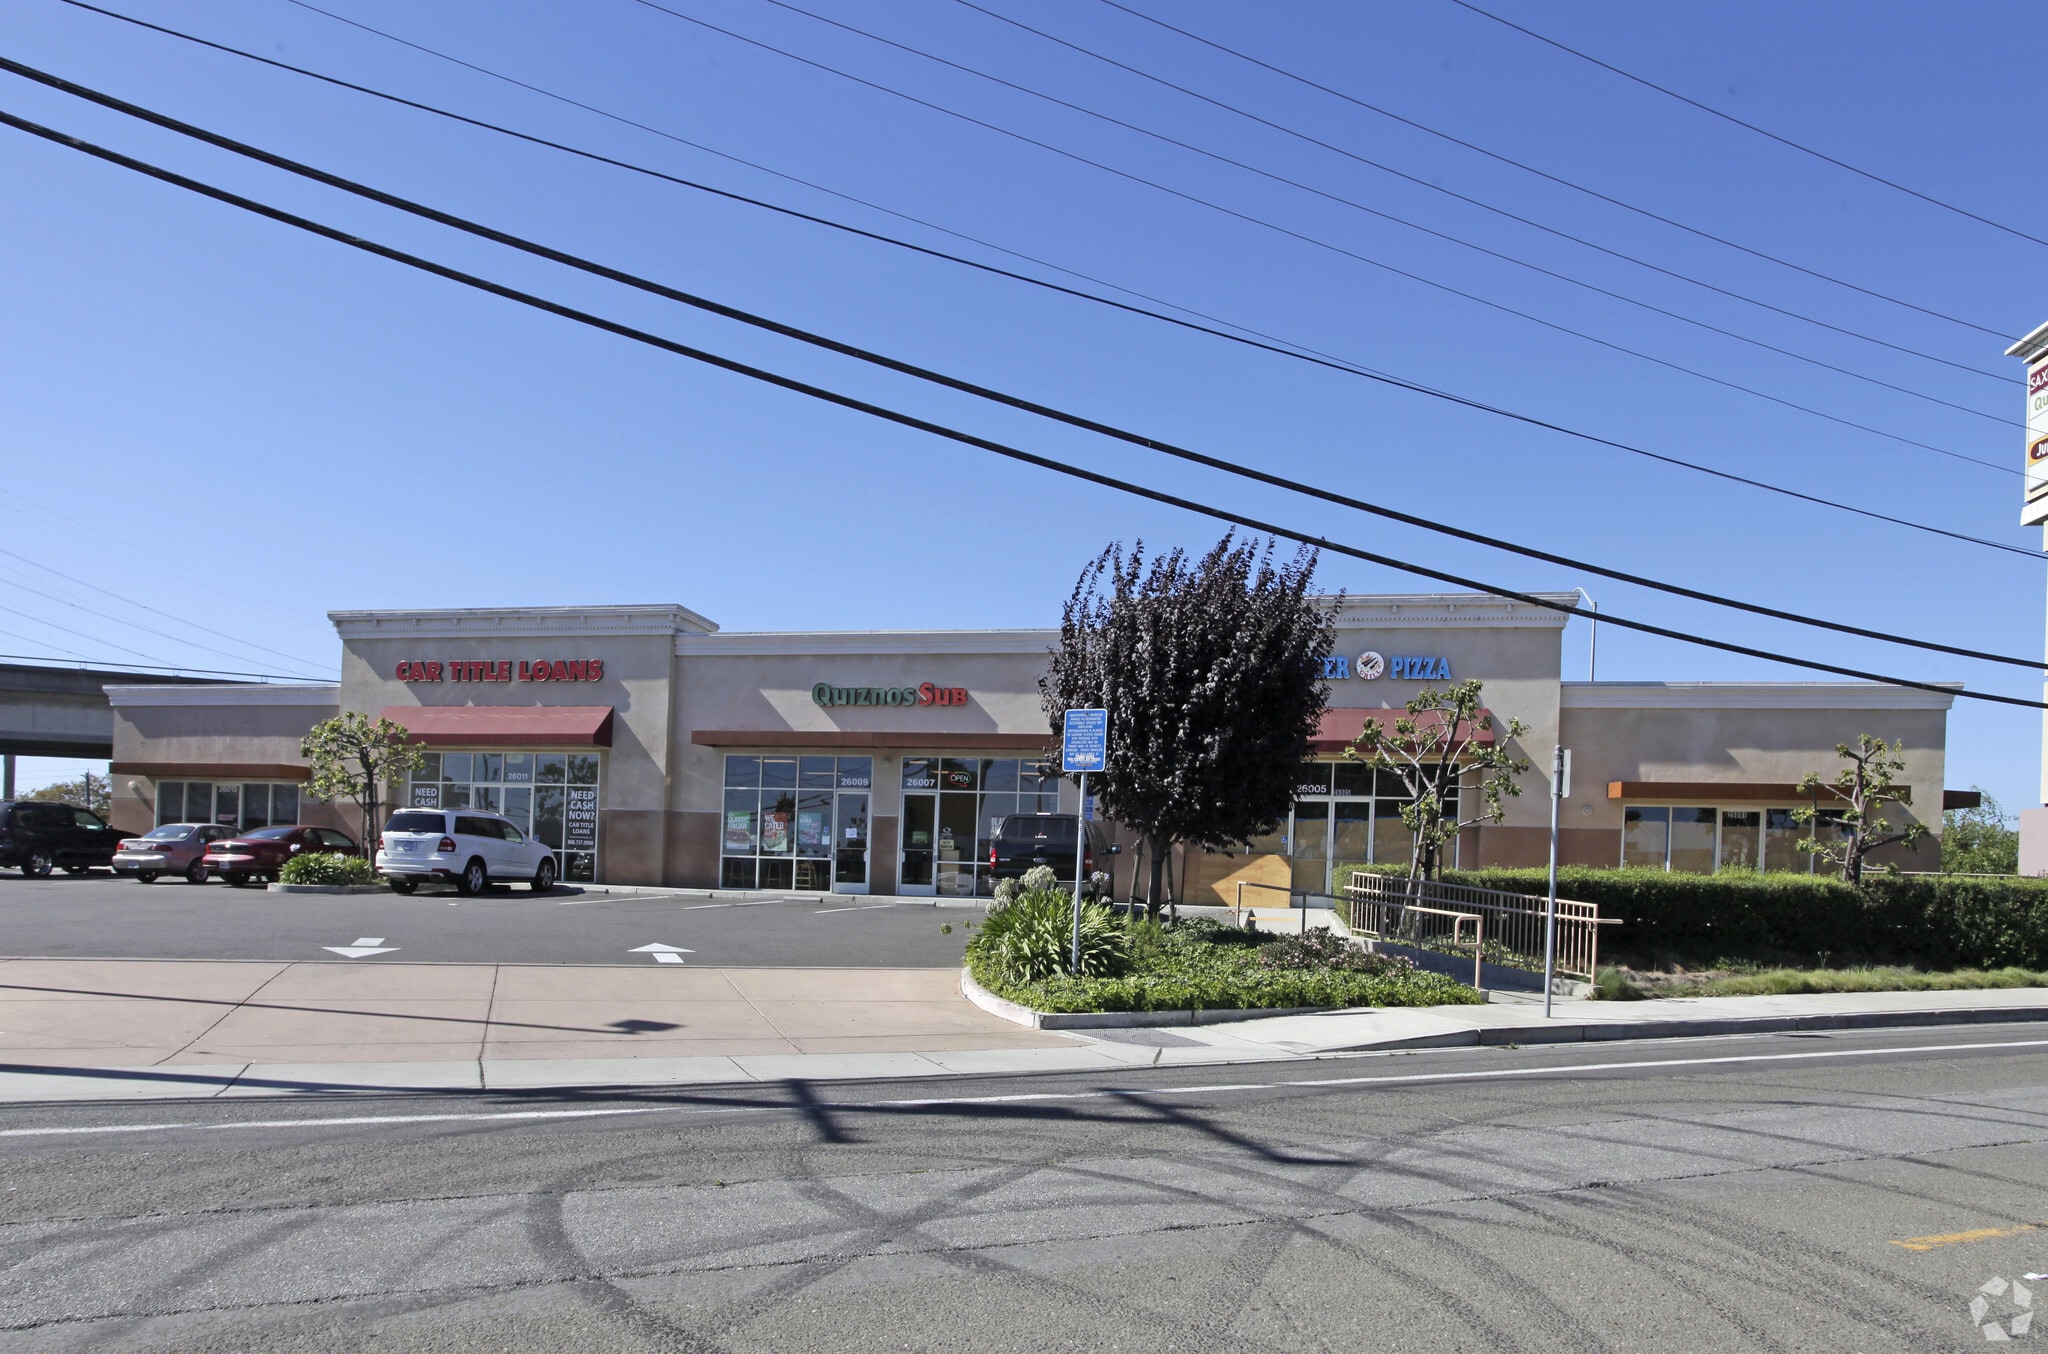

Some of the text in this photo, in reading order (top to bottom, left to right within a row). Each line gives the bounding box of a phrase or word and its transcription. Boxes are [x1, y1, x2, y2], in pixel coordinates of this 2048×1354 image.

[396, 659, 604, 682] CAR TITLE LOANS
[1390, 656, 1452, 680] PIZZA
[1359, 668, 1382, 680] GRILL
[841, 778, 869, 786] 26009
[906, 778, 935, 787] 26007
[950, 774, 969, 782] OPEN
[415, 788, 438, 797] NEED
[571, 790, 595, 800] NEED
[414, 798, 437, 806] CASH
[570, 801, 594, 810] CASH
[569, 811, 595, 820] NOW?
[764, 814, 775, 822] WE
[764, 821, 784, 830] CATER
